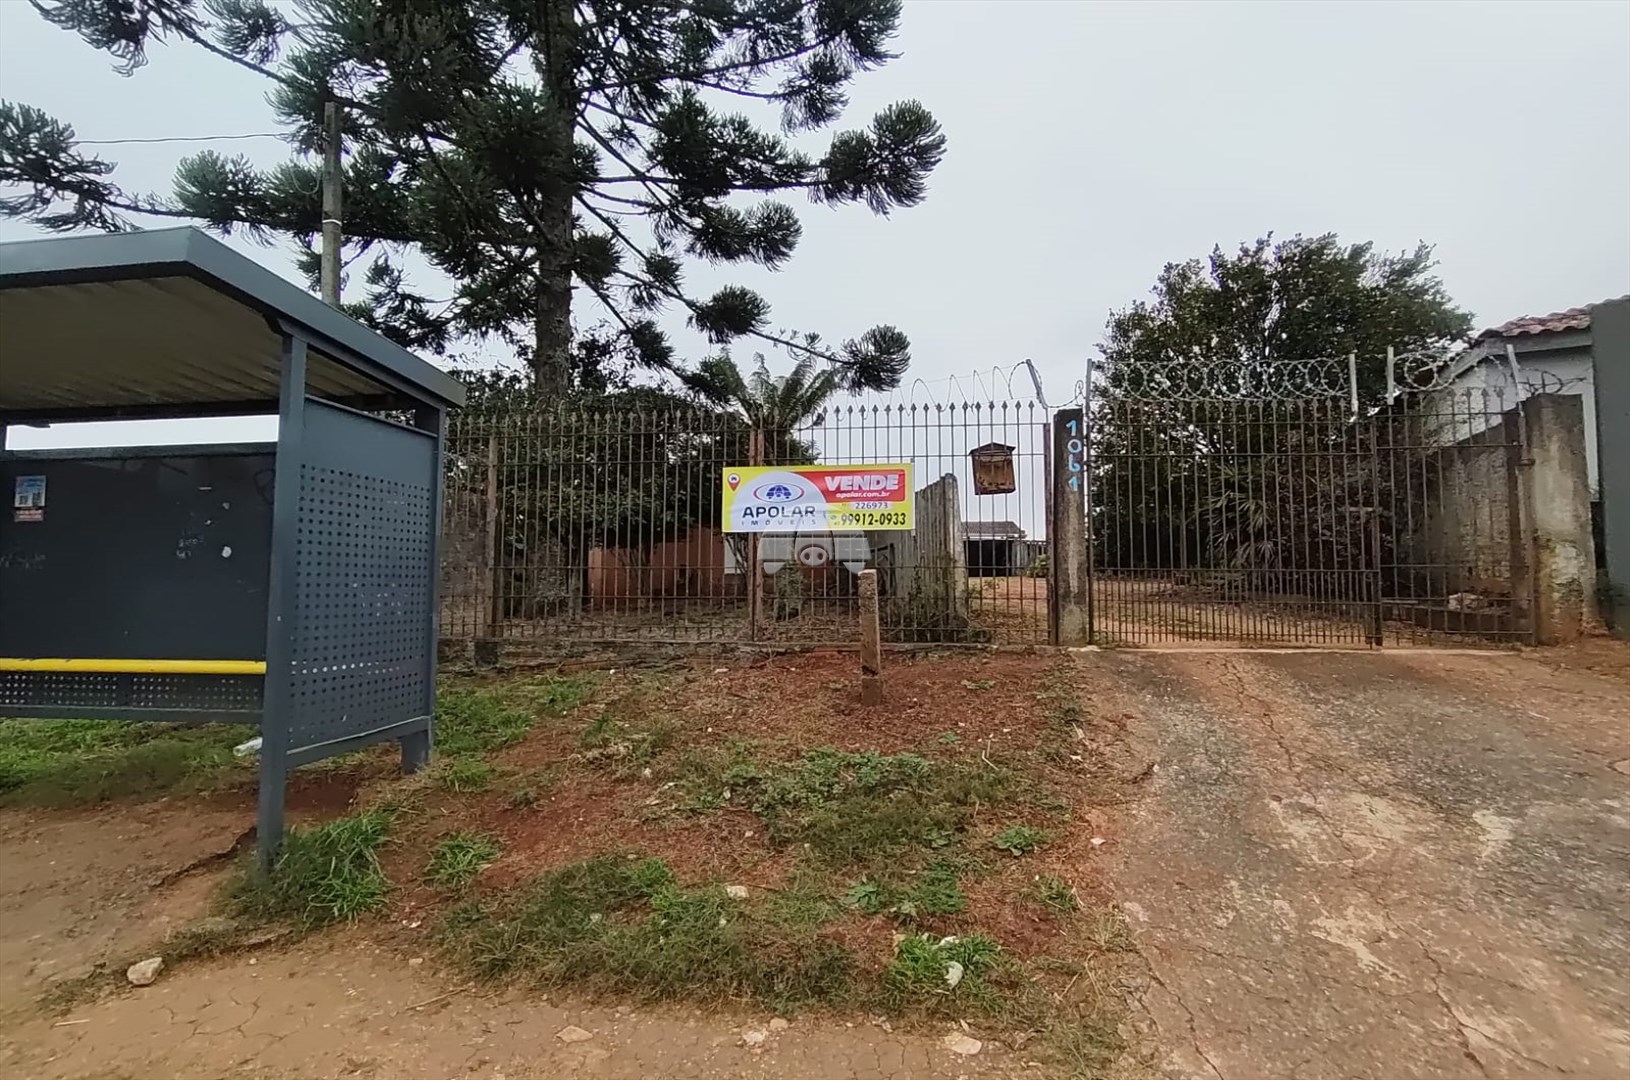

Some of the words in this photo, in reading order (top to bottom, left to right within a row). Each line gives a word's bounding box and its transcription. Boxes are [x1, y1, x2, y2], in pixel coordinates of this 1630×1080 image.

[825, 474, 899, 491] VENDE
[835, 490, 891, 499] apolar.com.br
[742, 506, 816, 519] APOLAR
[855, 502, 889, 510] 226973
[841, 513, 907, 526] 99912-0933
